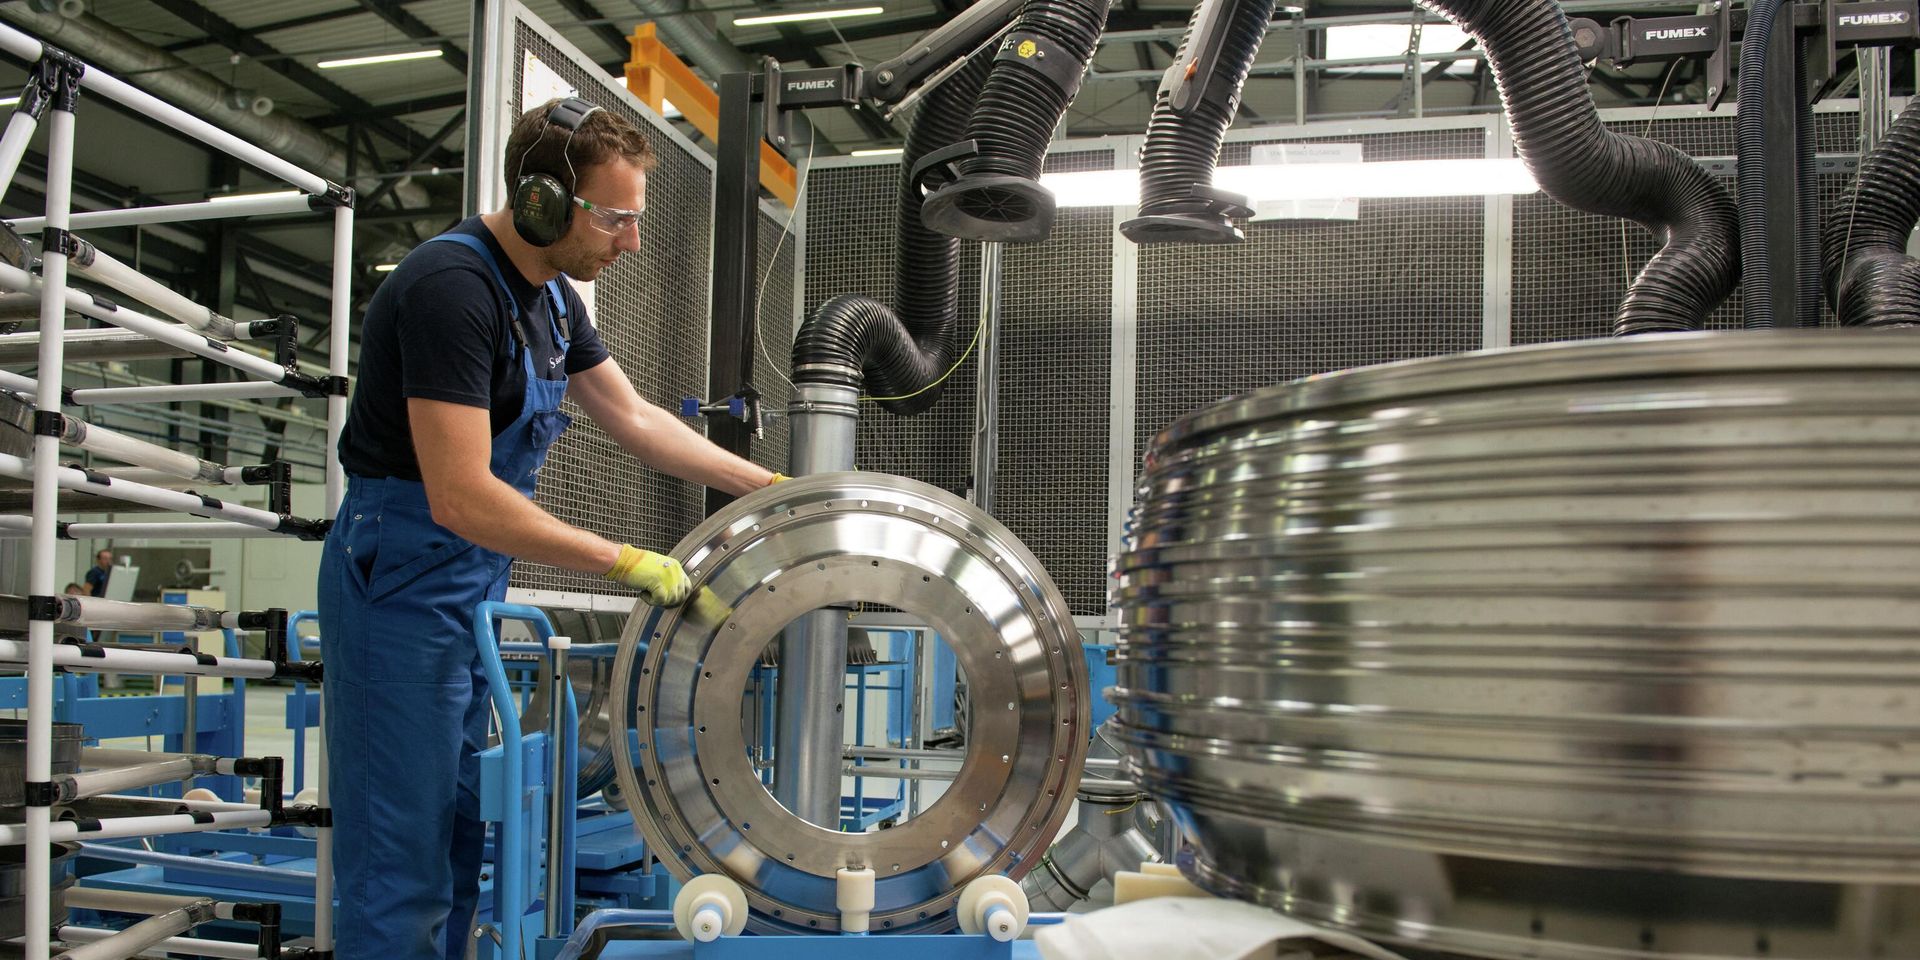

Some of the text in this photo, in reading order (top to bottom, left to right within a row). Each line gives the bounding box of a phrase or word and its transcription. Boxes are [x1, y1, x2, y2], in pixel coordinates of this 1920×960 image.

[1839, 12, 1903, 26] FUMEX
[1645, 27, 1707, 41] FUMEX
[787, 79, 835, 91] FUMEX
